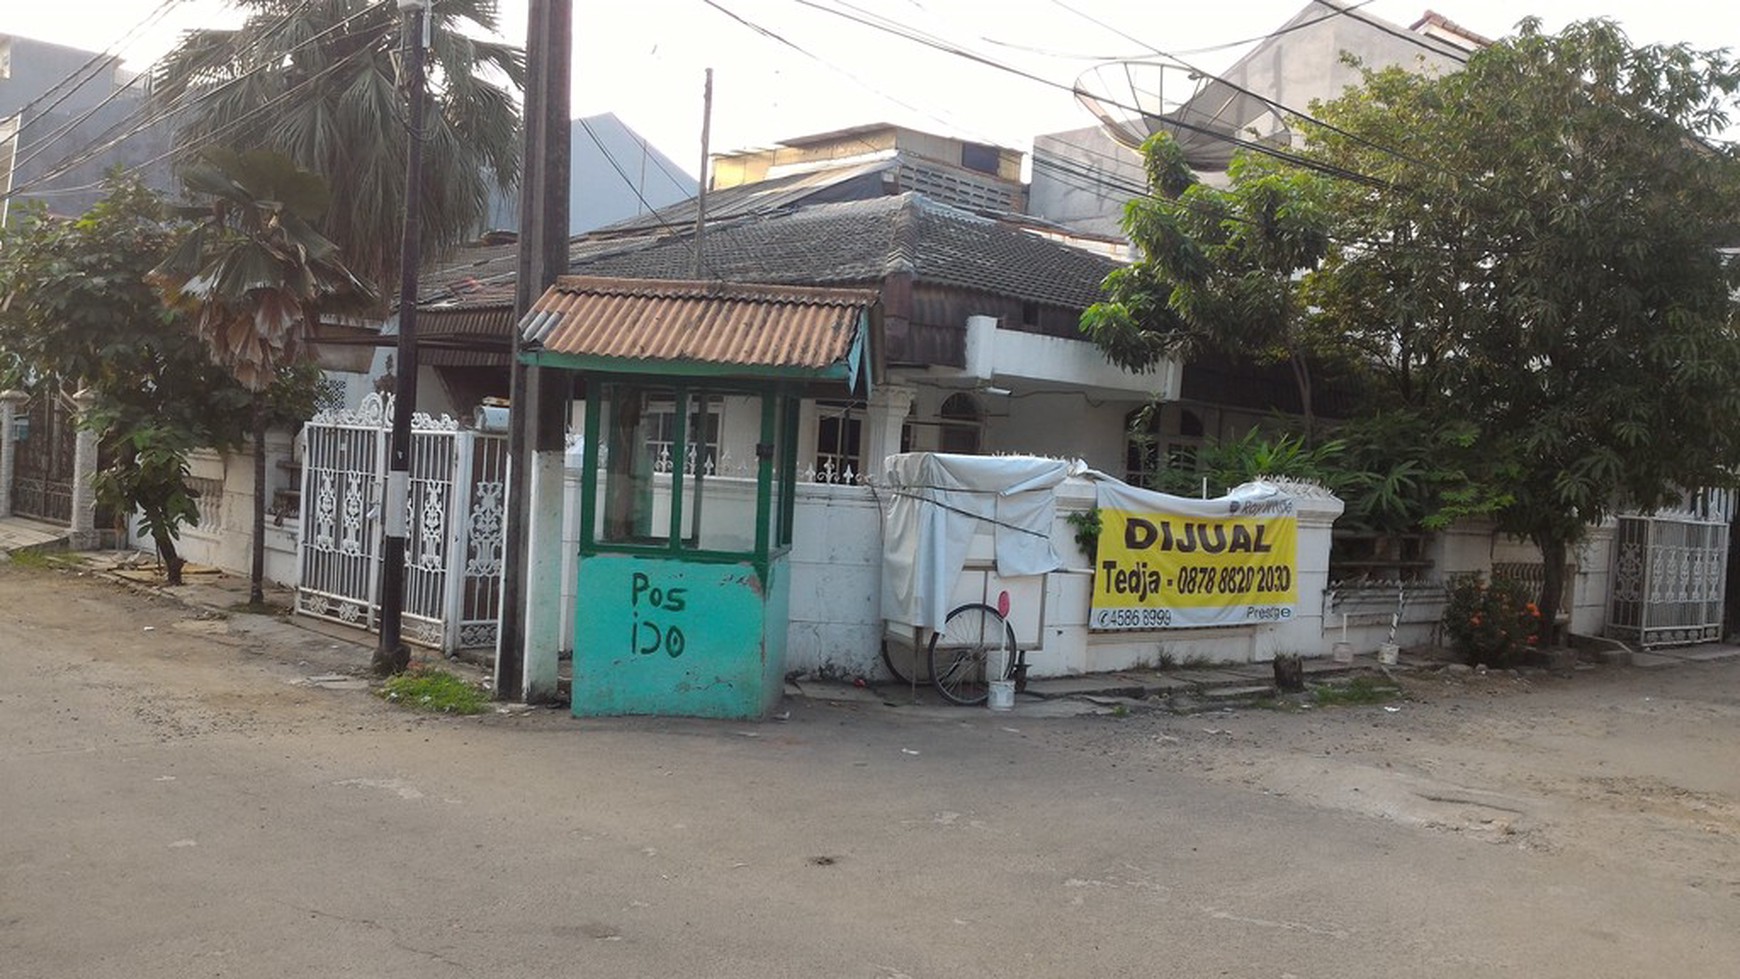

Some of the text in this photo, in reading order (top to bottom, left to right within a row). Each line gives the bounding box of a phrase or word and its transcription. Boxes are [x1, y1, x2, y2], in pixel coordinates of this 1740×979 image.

[1125, 518, 1271, 553] DIJUAL
[1102, 560, 1161, 602] Tedja
[1177, 565, 1216, 594] 0878
[1256, 565, 1291, 592] 2030
[1111, 609, 1140, 626] 4586
